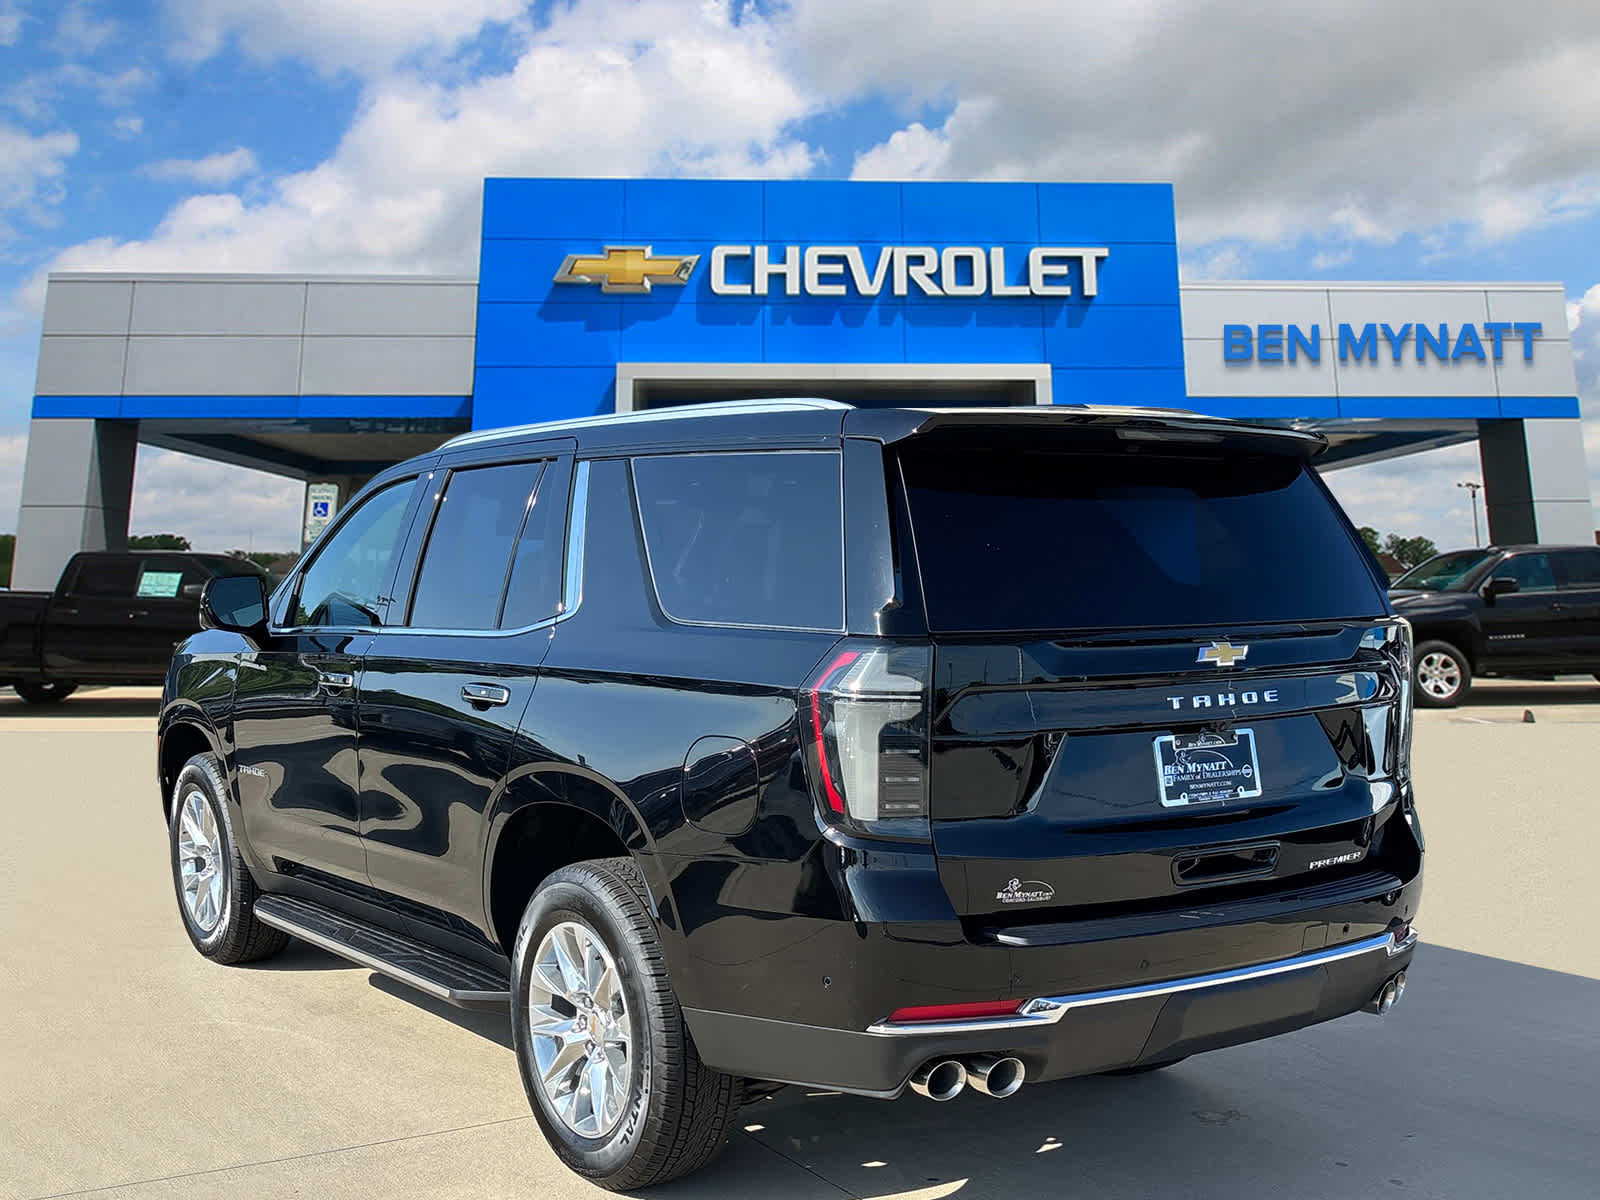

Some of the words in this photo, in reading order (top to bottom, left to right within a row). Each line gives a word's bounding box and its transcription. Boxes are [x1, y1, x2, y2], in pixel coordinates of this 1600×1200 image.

[710, 245, 1109, 297] CHEVROLET
[1223, 323, 1321, 363] BEN
[1338, 321, 1543, 363] MYNATT
[1166, 689, 1279, 710] TAHOE
[238, 764, 265, 778] TAHOE
[1164, 764, 1186, 776] BEN
[1187, 760, 1227, 774] MYNATT
[1173, 774, 1195, 783] FAMILY
[1202, 769, 1241, 780] DEALERSHIPS
[1309, 851, 1361, 870] PREMIER
[996, 891, 1014, 899] BEN
